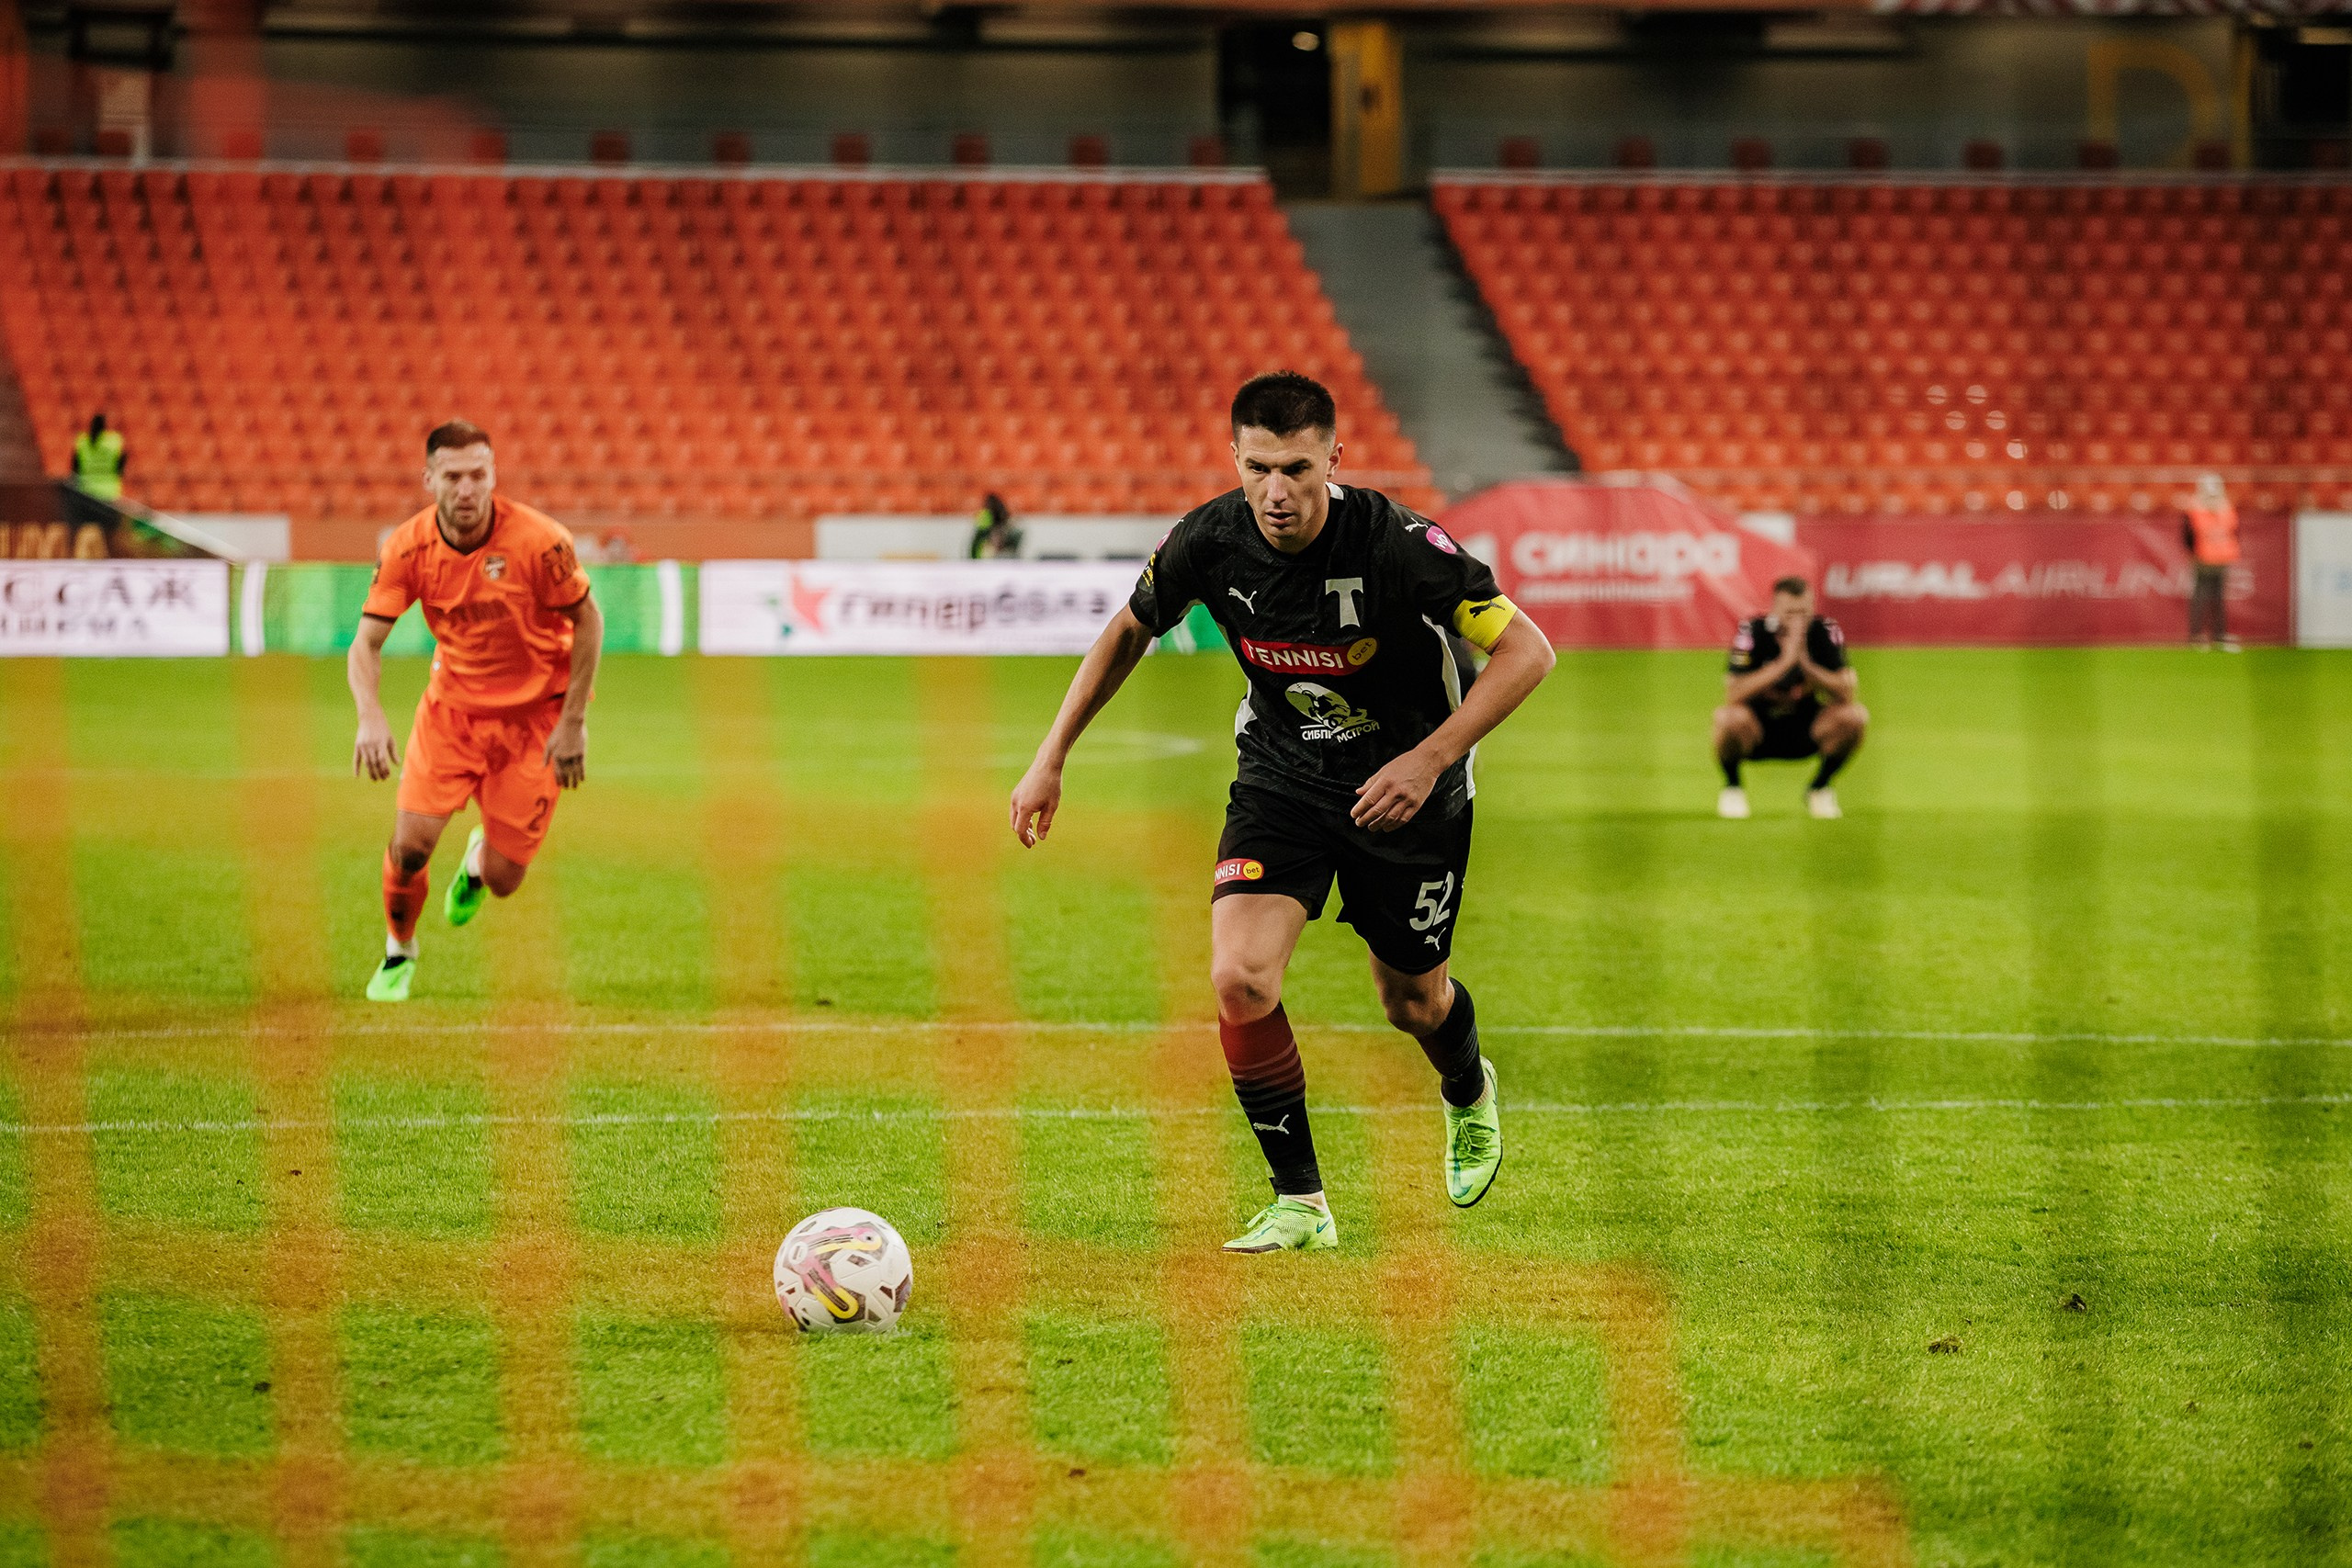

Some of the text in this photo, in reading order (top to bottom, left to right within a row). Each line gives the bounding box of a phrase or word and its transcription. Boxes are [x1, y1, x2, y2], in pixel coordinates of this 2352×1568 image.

[1824, 559, 2256, 601] URAL AIRLINS
[1244, 639, 1373, 669] TENNISI bet
[527, 795, 548, 831] 2
[1408, 871, 1455, 931] 52
